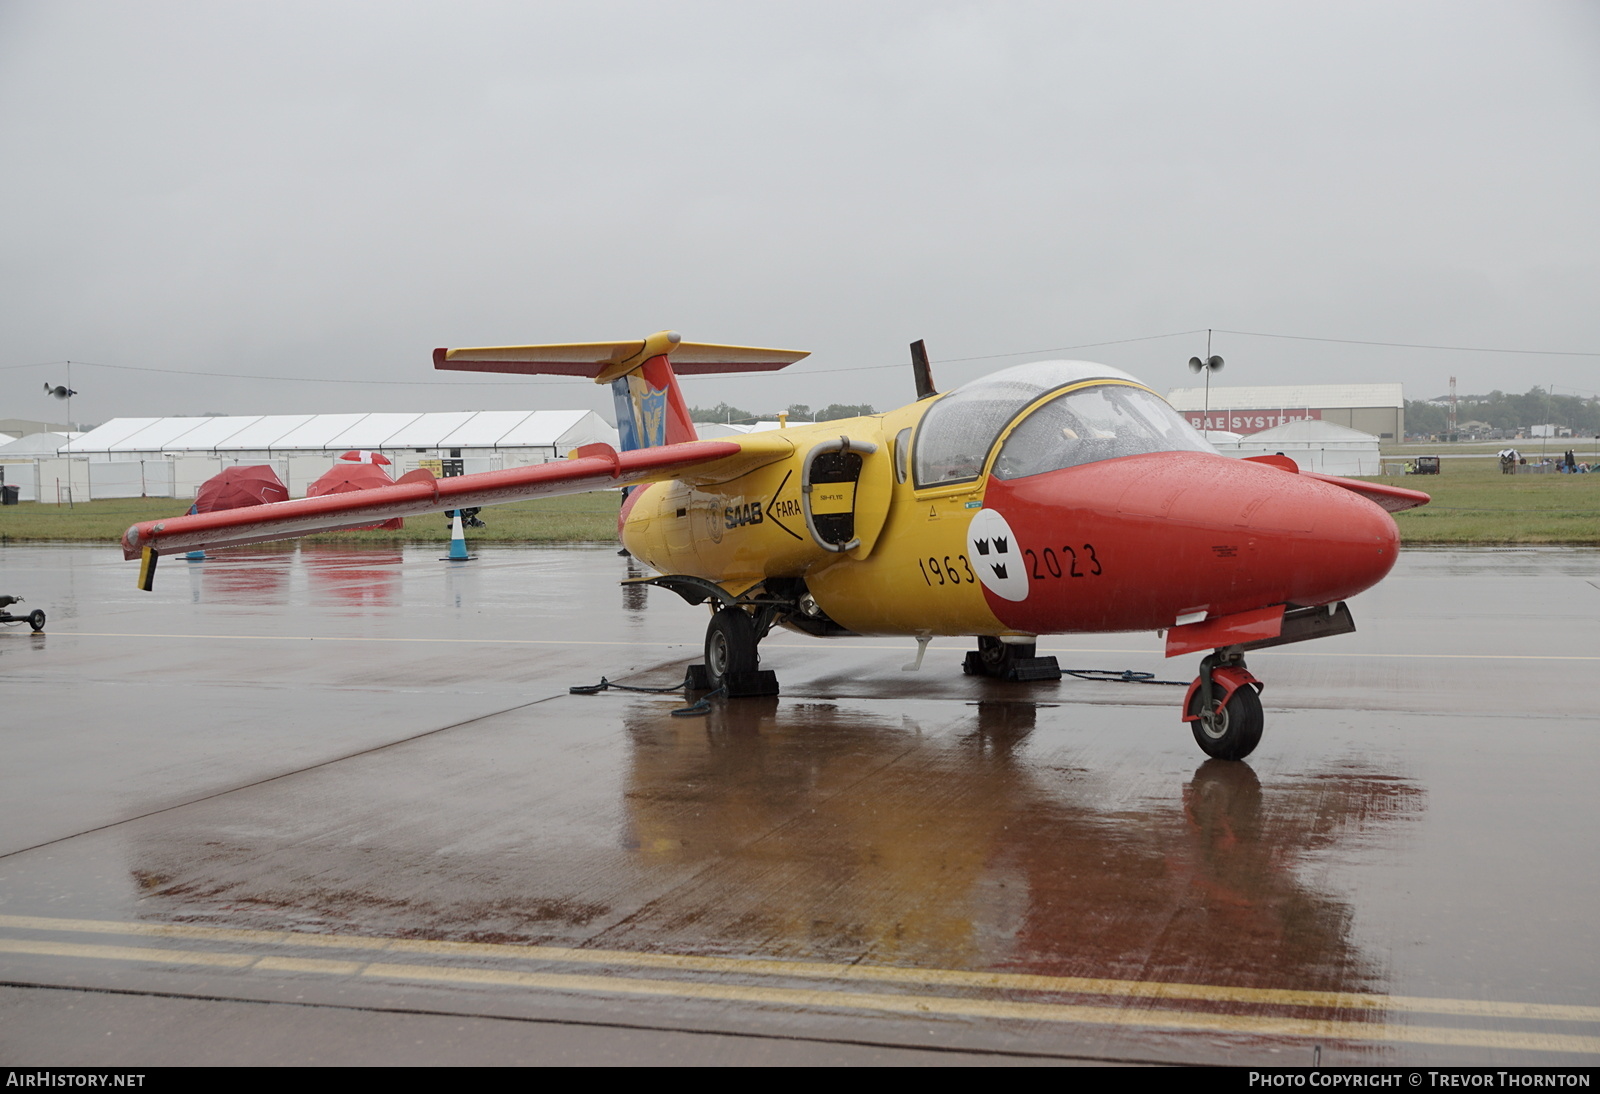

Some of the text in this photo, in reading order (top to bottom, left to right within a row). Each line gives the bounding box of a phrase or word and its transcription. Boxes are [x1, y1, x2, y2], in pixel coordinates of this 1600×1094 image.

[1191, 417, 1225, 429] BAE
[724, 502, 763, 529] SAAB
[776, 499, 802, 518] FARA
[919, 544, 1102, 586] 1963 2023
